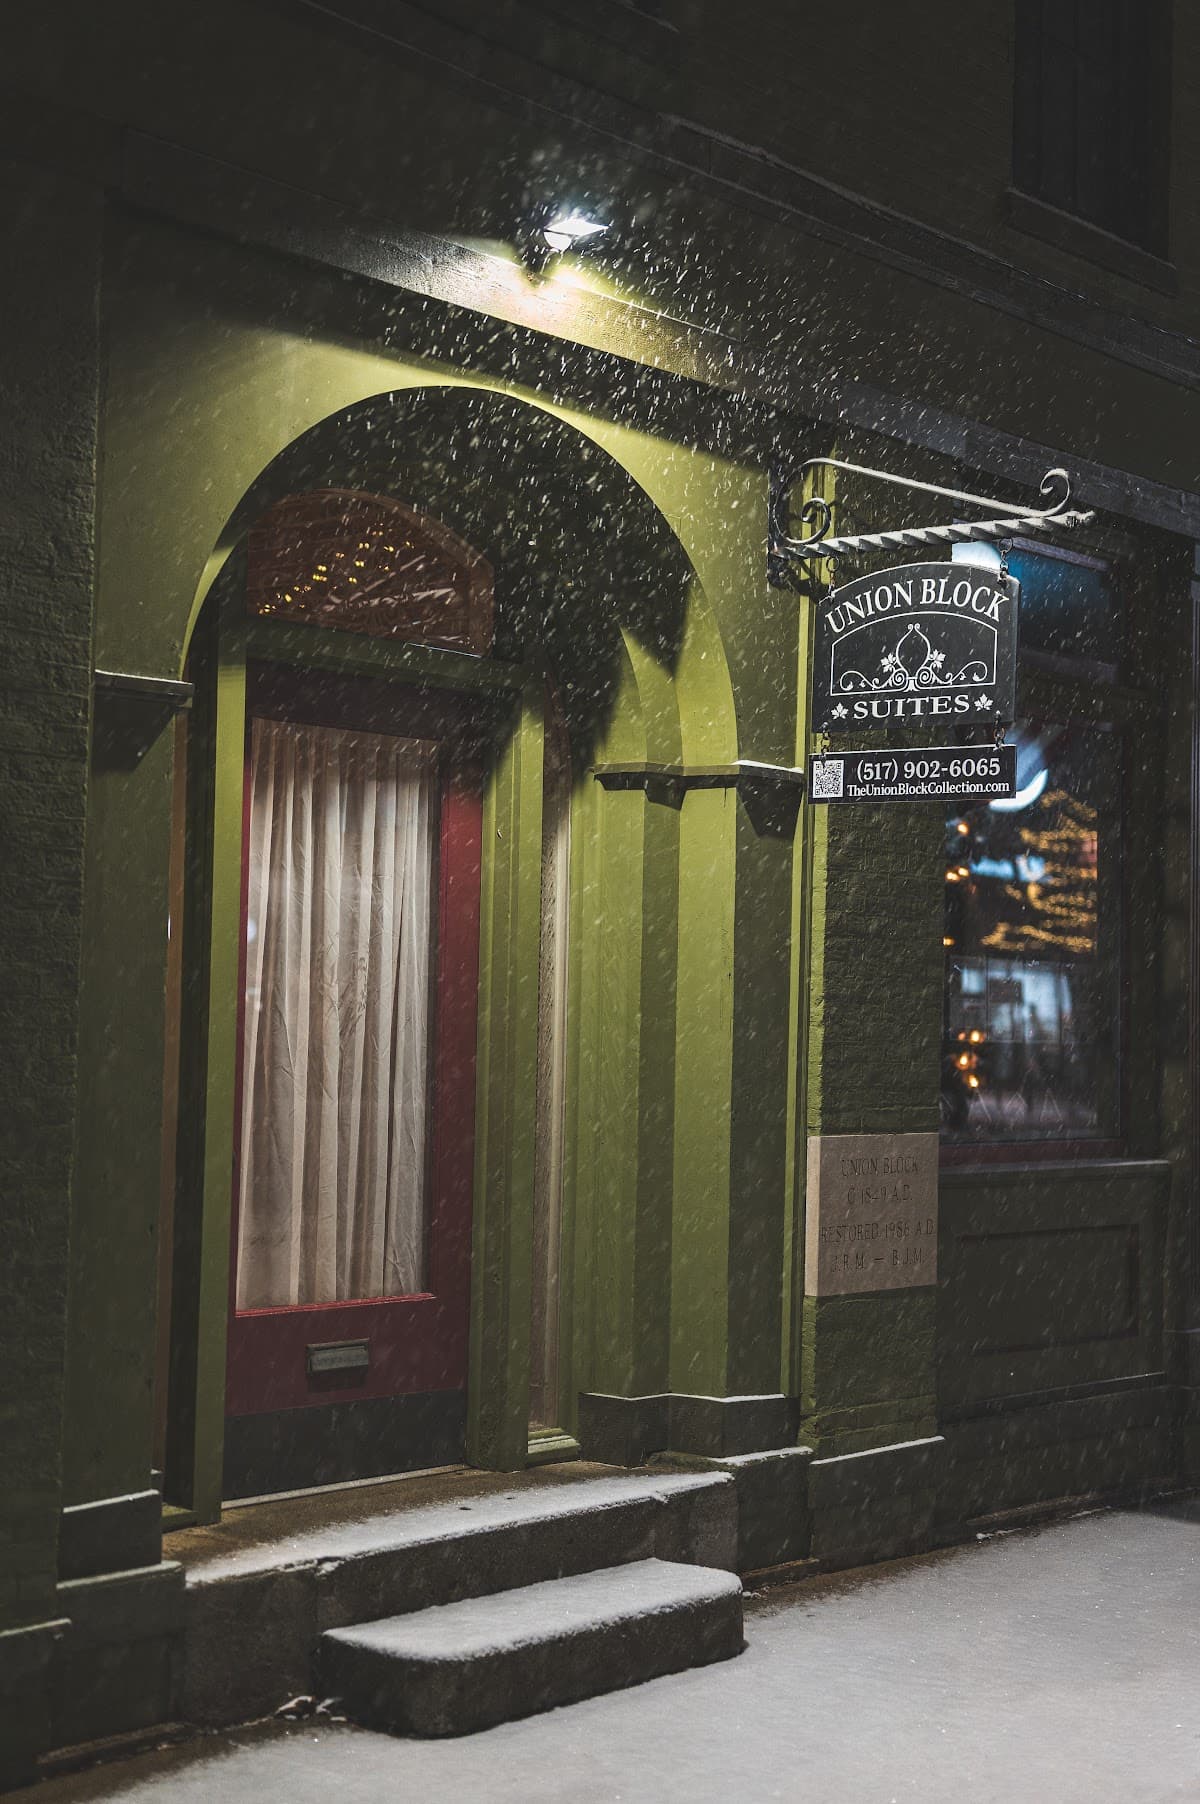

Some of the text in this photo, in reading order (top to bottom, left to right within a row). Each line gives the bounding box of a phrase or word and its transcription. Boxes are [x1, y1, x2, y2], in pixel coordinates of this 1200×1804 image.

[825, 577, 1010, 634] UNION BLOCK
[853, 694, 970, 720] SUITES
[856, 757, 1001, 784] (517) 902-6065
[847, 781, 1010, 797] TheUnionBlockCollection.com
[841, 1156, 918, 1176] UNION BLOCK
[820, 1222, 879, 1243] RESTORED
